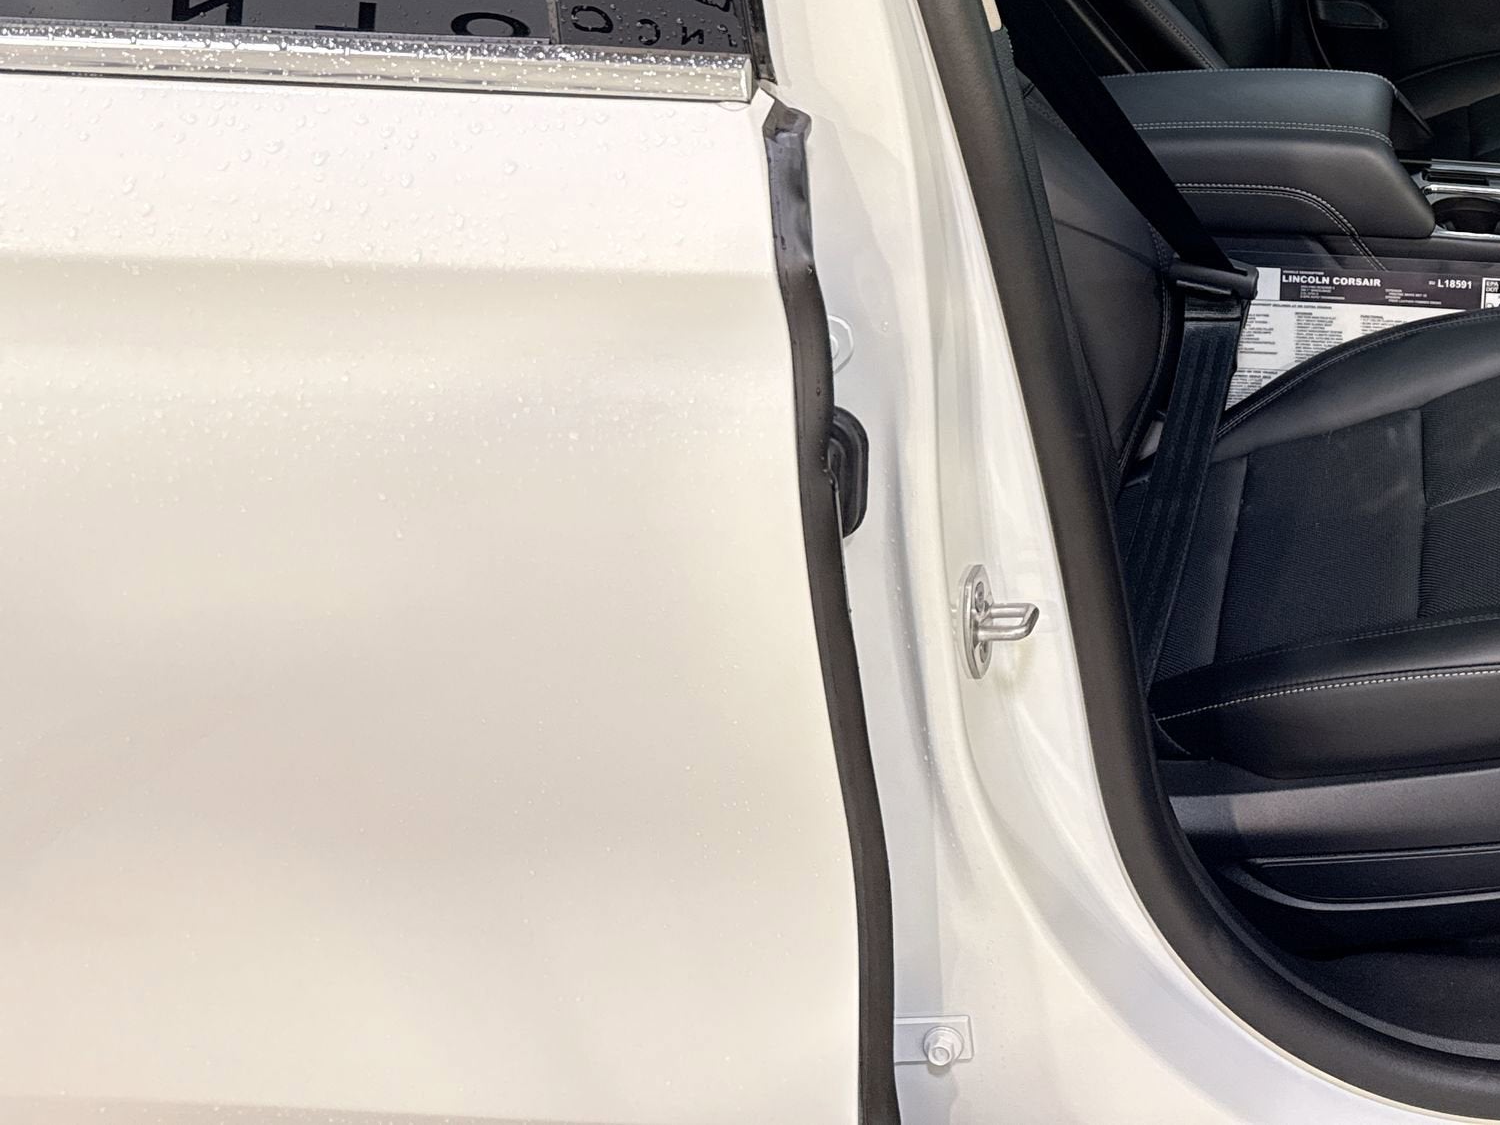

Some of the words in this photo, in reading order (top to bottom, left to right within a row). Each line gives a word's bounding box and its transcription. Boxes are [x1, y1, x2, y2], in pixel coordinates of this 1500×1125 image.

[1282, 275, 1330, 285] LINCOLN
[1332, 277, 1381, 287] CORSAIR
[1437, 279, 1472, 289] L18591
